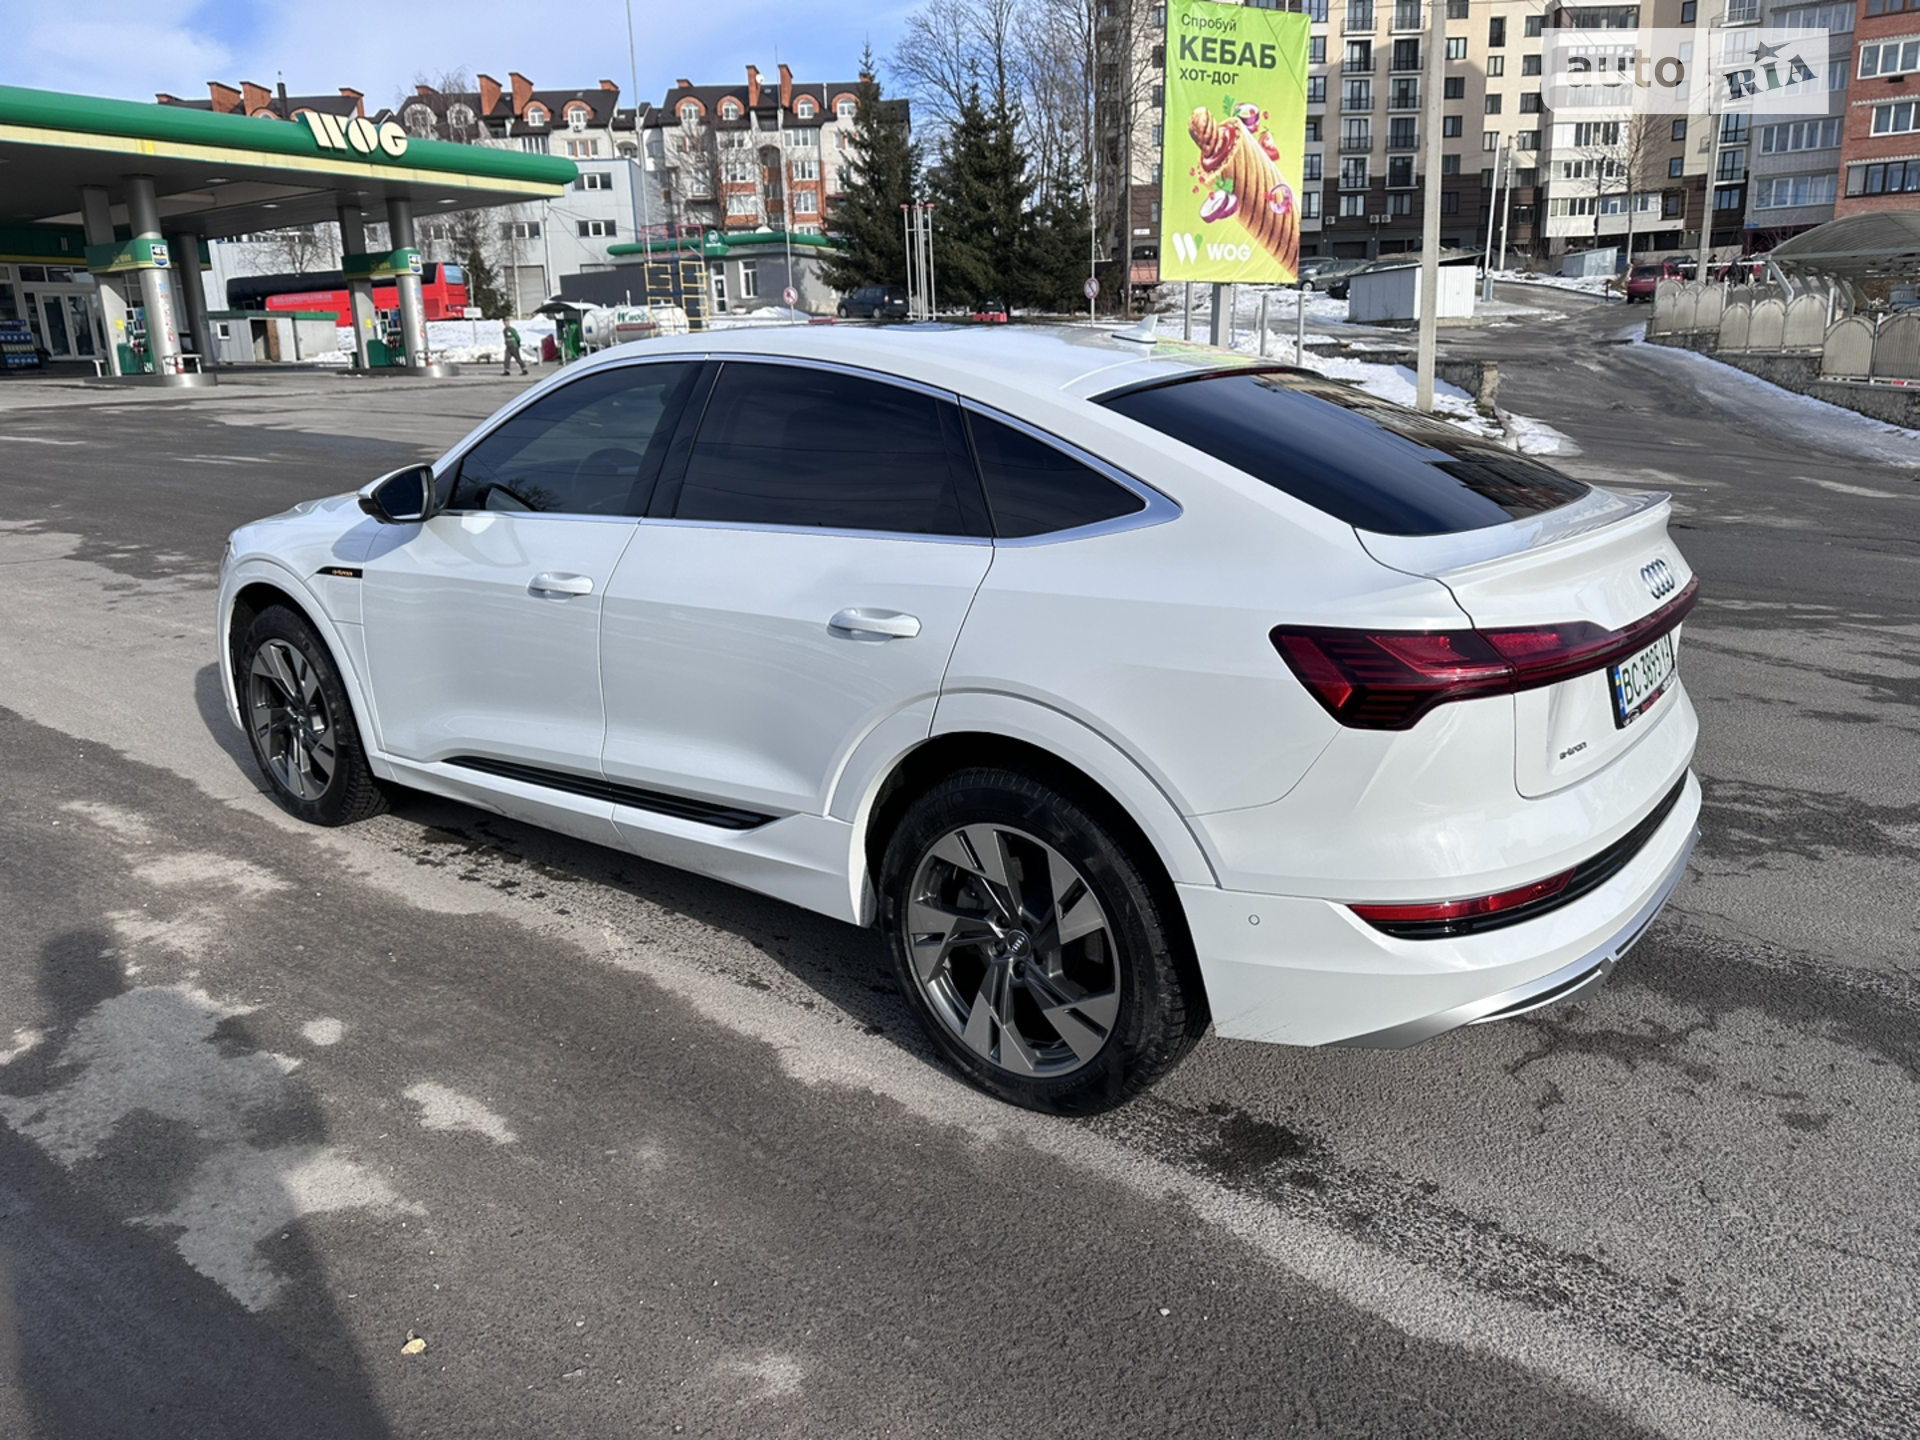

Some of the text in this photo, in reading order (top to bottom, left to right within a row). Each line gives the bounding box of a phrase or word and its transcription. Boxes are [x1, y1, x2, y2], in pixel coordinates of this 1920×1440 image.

[1181, 13, 1237, 33] Спробуй
[1179, 34, 1277, 70] КЕБАБ
[303, 111, 408, 156] WOG
[1206, 243, 1251, 262] WOG
